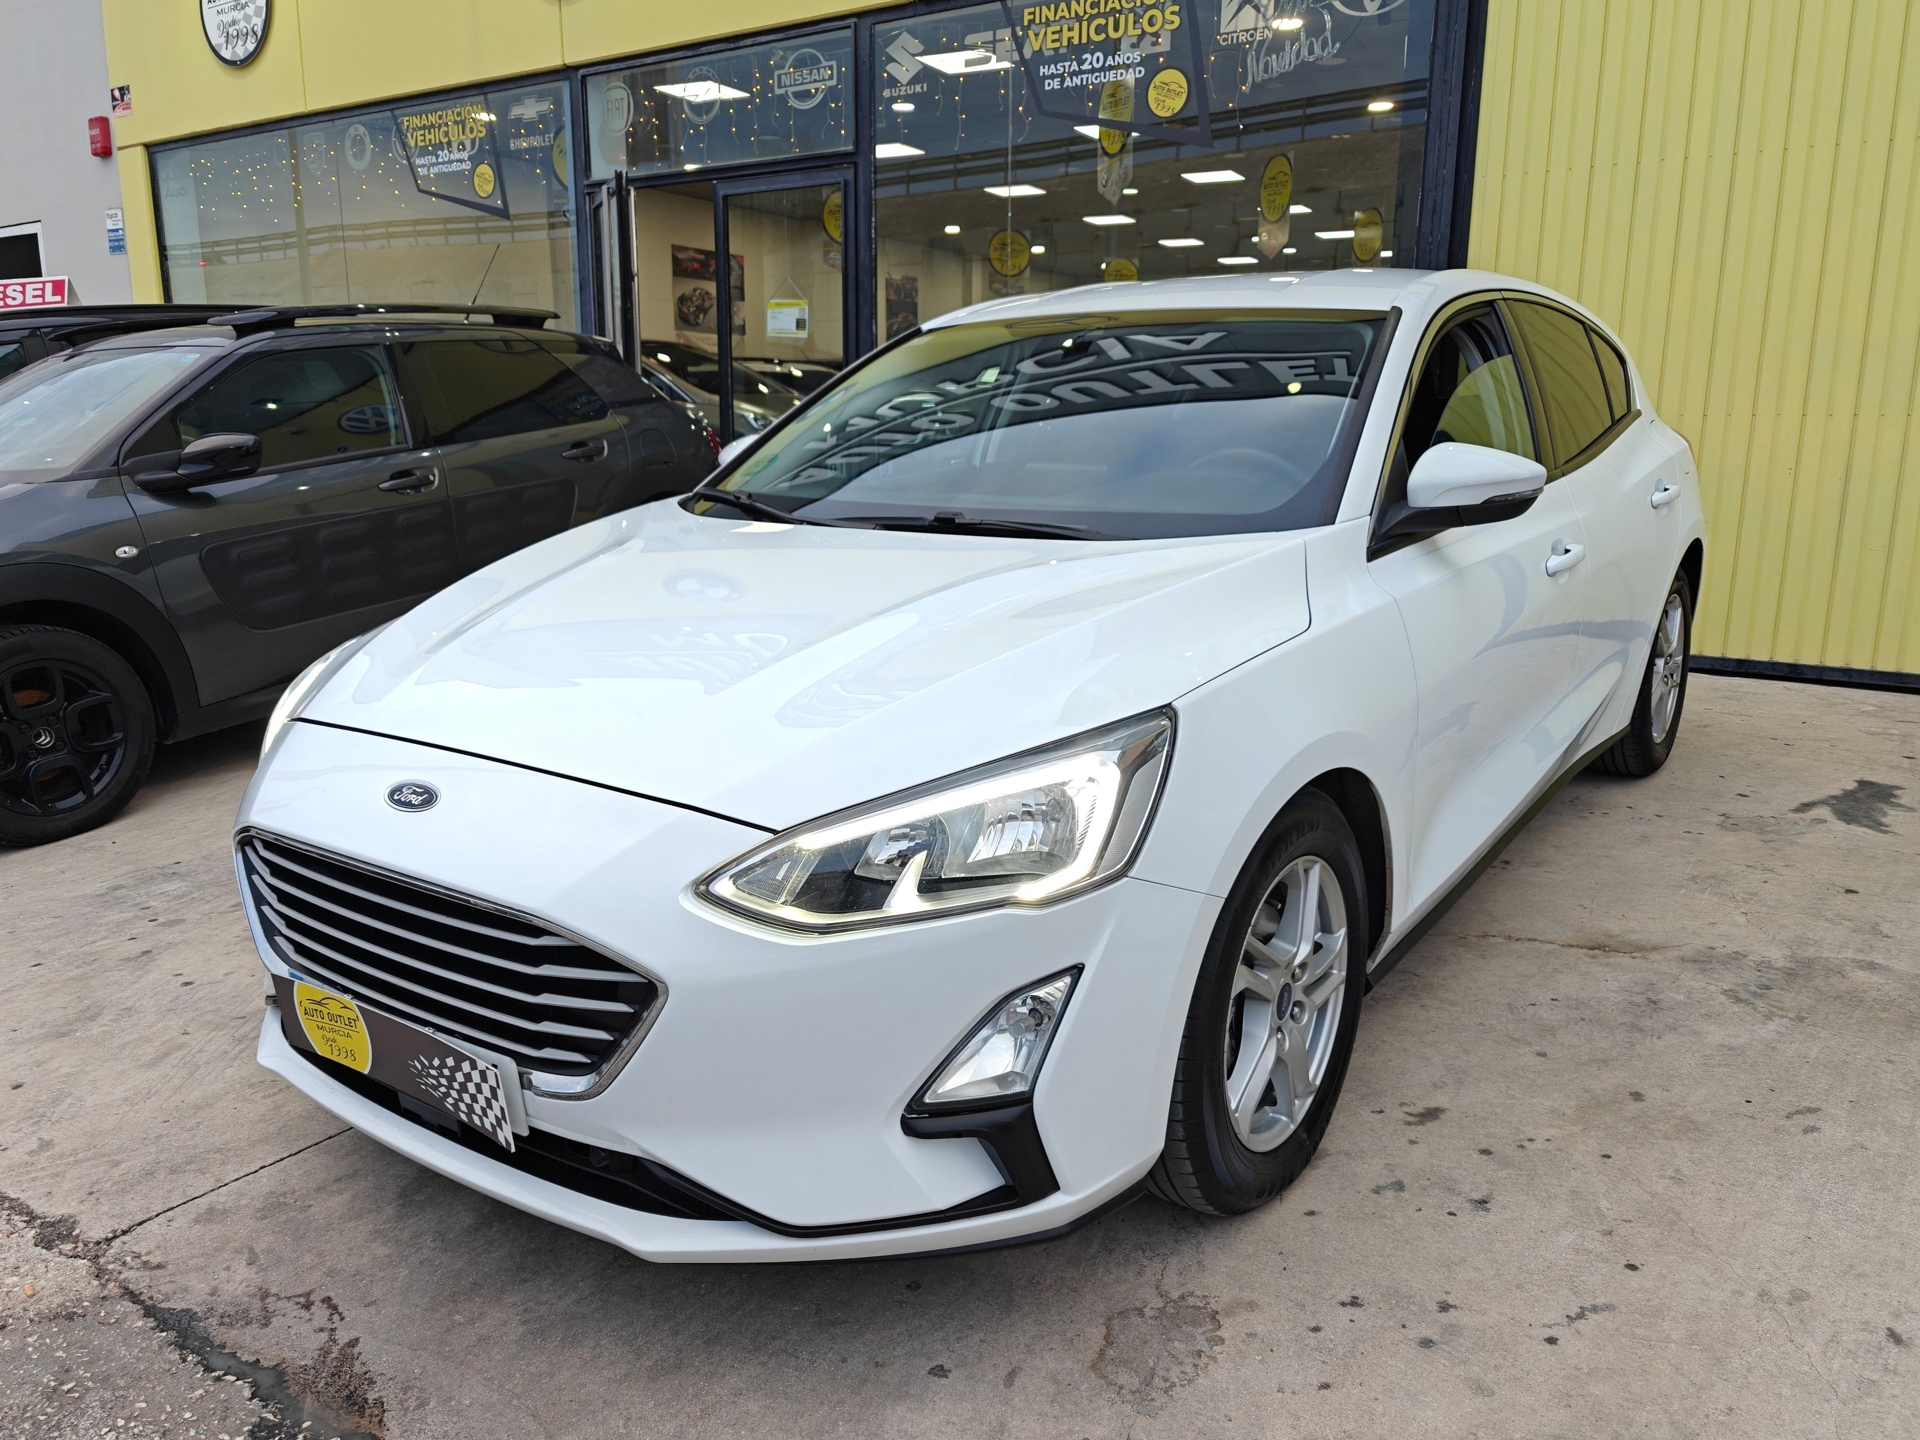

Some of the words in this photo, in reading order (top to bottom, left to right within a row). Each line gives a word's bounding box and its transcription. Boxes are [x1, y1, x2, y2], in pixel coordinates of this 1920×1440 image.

[216, 1, 250, 17] MURCIA
[224, 23, 259, 51] 1998
[1027, 5, 1181, 51] VEHÍCULOS
[1219, 26, 1273, 46] CITROËN
[1039, 60, 1080, 77] HASTA
[1081, 51, 1105, 71] 20
[1105, 51, 1142, 67] AÑOS
[780, 66, 831, 88] NISSAN
[1044, 79, 1062, 91] DE
[1063, 66, 1146, 88] ANTIGUEDAD
[883, 82, 928, 98] SUZUKI
[403, 102, 482, 130] FINANCIACIÓN
[406, 121, 487, 148] VEHÍCULOS
[415, 155, 437, 166] HASTA
[437, 149, 450, 163] 20
[419, 167, 429, 176] DE
[429, 161, 472, 174] ANTIGUEDAD
[0, 282, 62, 306] SEL
[393, 785, 429, 805] Ford
[303, 1006, 325, 1020] AUTO
[327, 1011, 358, 1029] OUTLET
[316, 1023, 354, 1040] MURCIA
[328, 1042, 357, 1062] 1998
